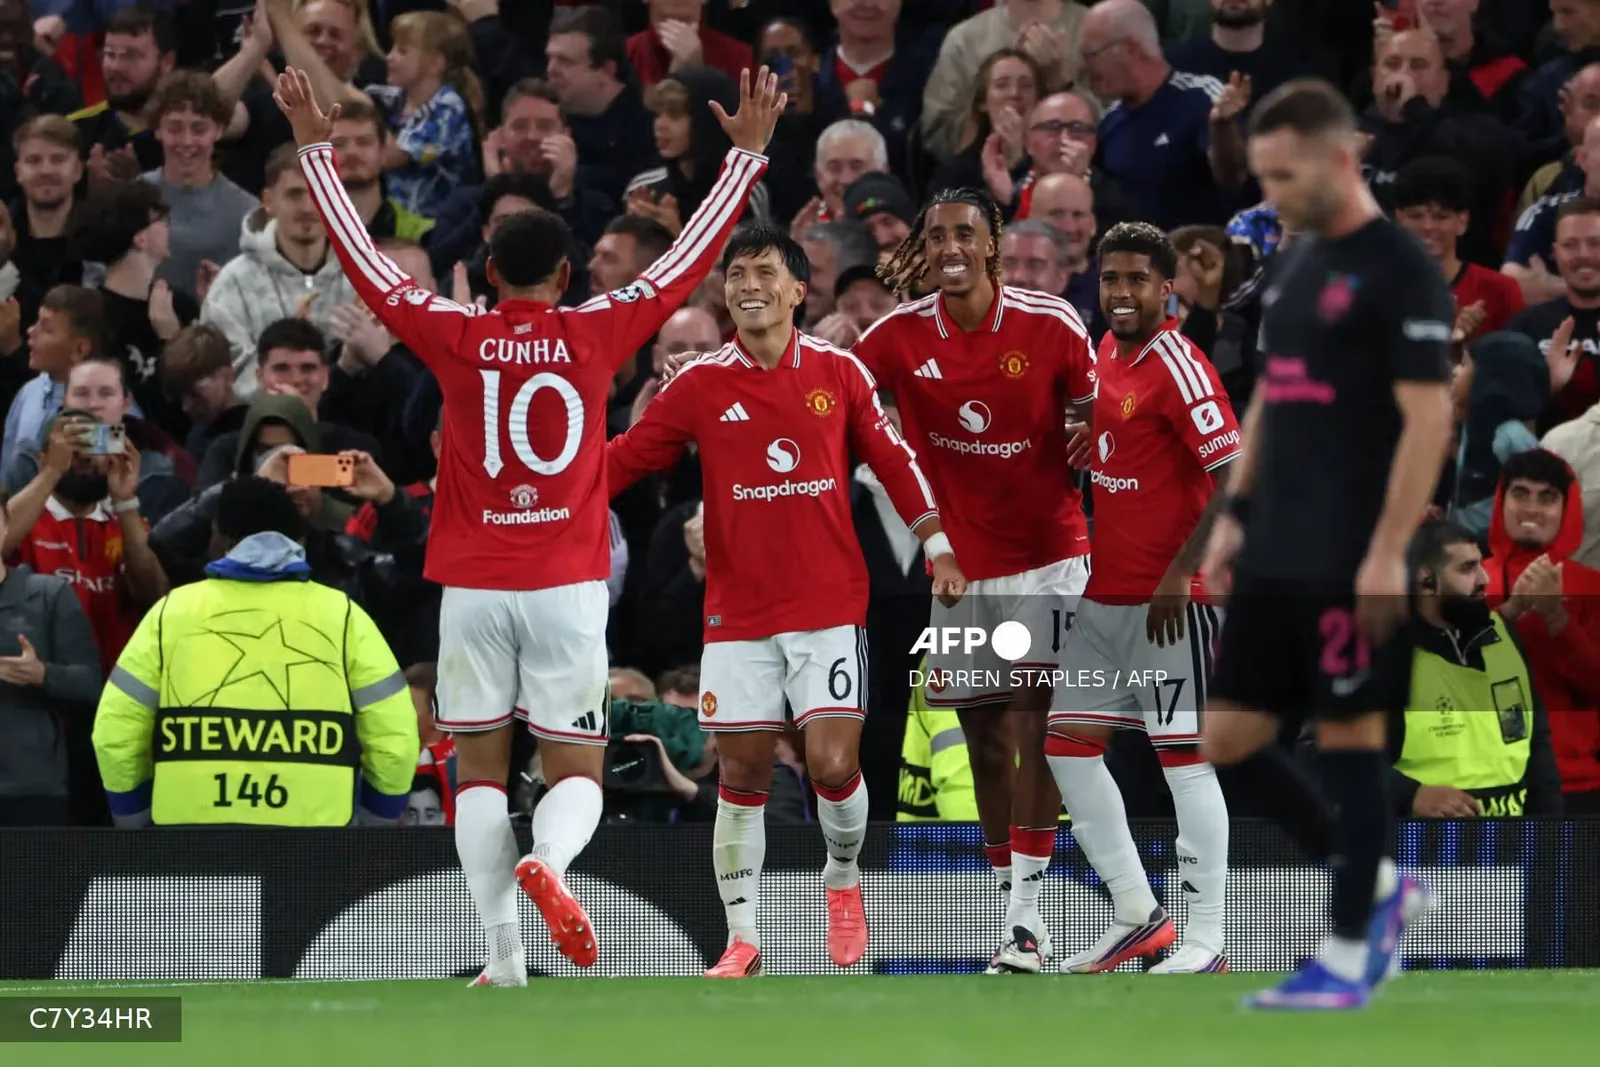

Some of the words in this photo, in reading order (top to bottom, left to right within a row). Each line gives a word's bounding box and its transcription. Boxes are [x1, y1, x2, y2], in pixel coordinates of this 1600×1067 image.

[479, 338, 571, 364] CUNHA
[478, 369, 585, 479] 10
[928, 431, 1032, 459] Snapdragon
[1198, 429, 1241, 459] sumup
[732, 477, 837, 502] Snapdragon
[483, 507, 570, 525] Foundation
[828, 657, 852, 701] 6
[1152, 677, 1187, 727] 17
[161, 716, 344, 755] STEWARD
[213, 772, 289, 809] 146
[720, 868, 753, 882] MUFC
